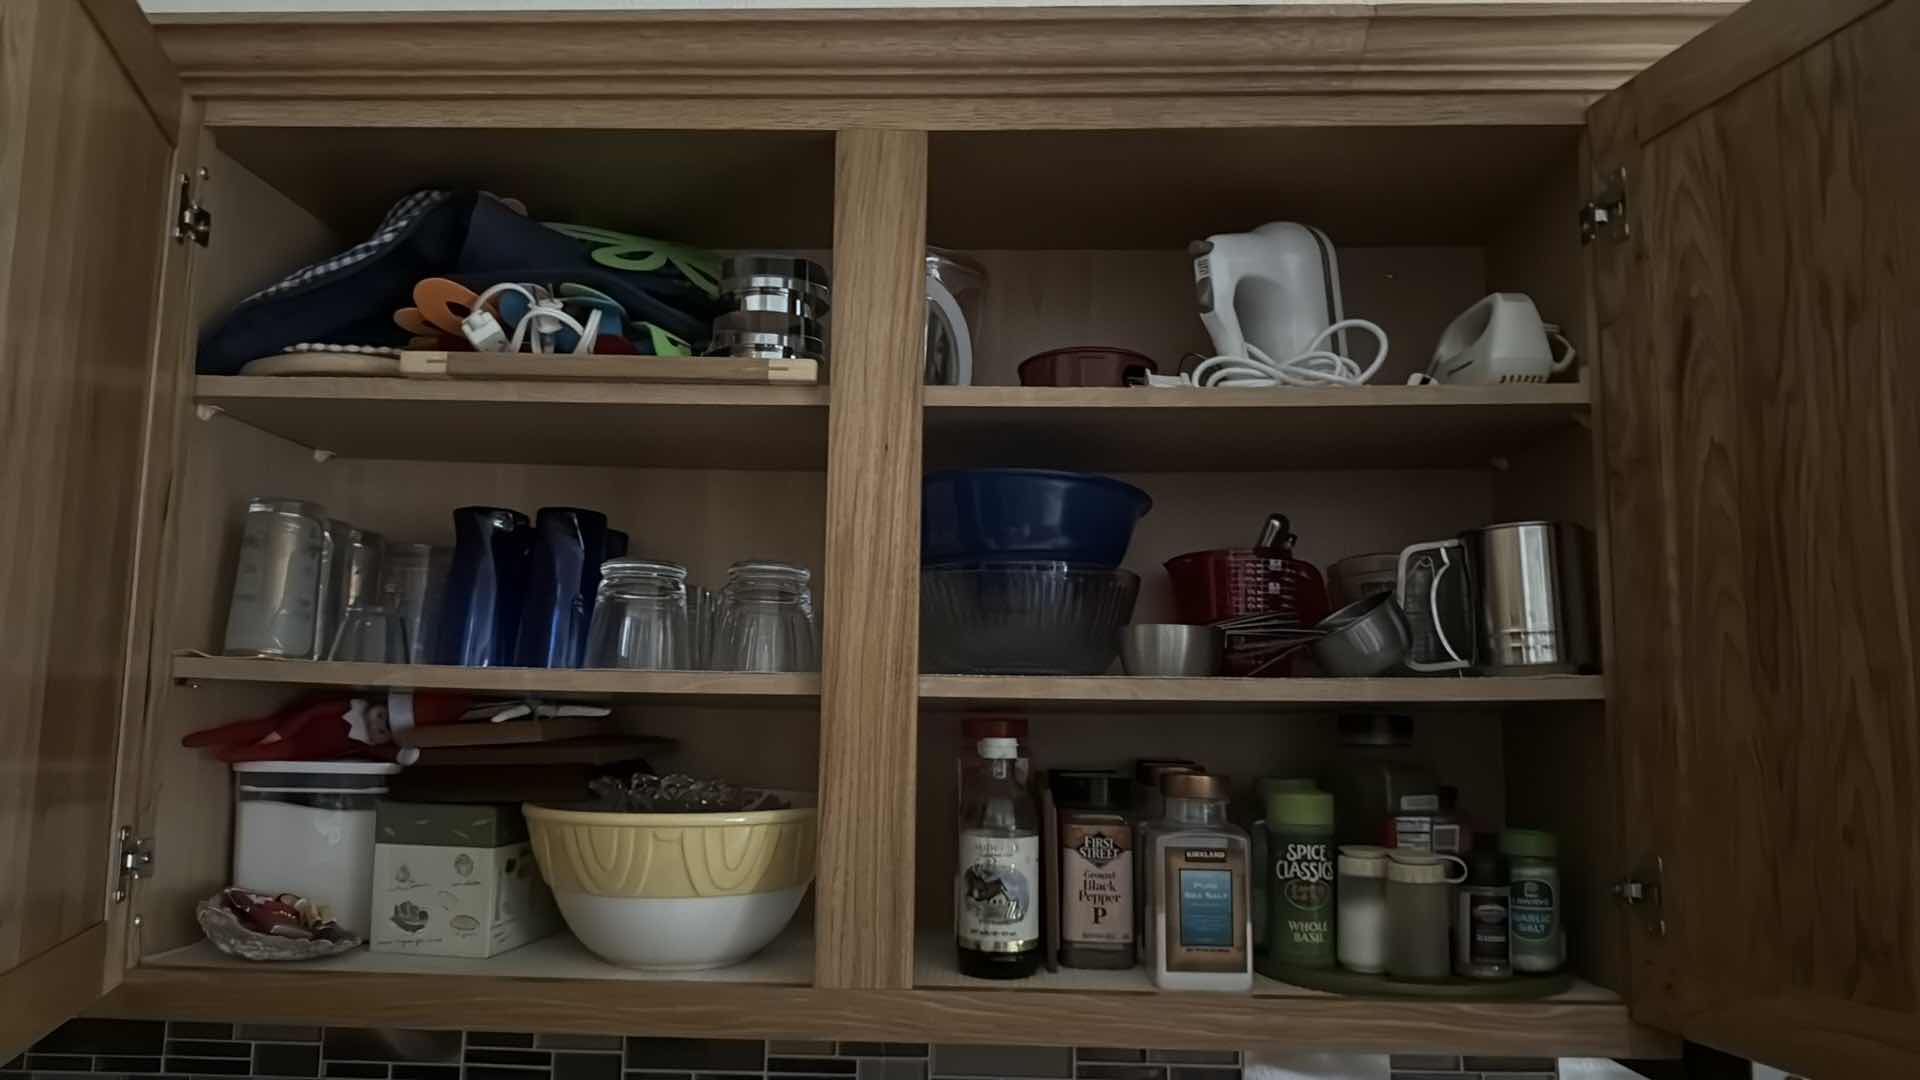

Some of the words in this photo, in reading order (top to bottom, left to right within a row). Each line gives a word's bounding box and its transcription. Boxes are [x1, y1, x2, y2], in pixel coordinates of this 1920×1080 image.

[1084, 835, 1114, 849] FIRST
[1079, 847, 1120, 860] STREET
[1285, 843, 1328, 861] SPICE
[1275, 860, 1334, 882] CLASSICS
[1083, 879, 1117, 892] Black
[1079, 890, 1121, 905] Pepper
[1093, 906, 1107, 924] P
[1287, 919, 1328, 932] WHOLE
[1293, 931, 1325, 944] BASIL
